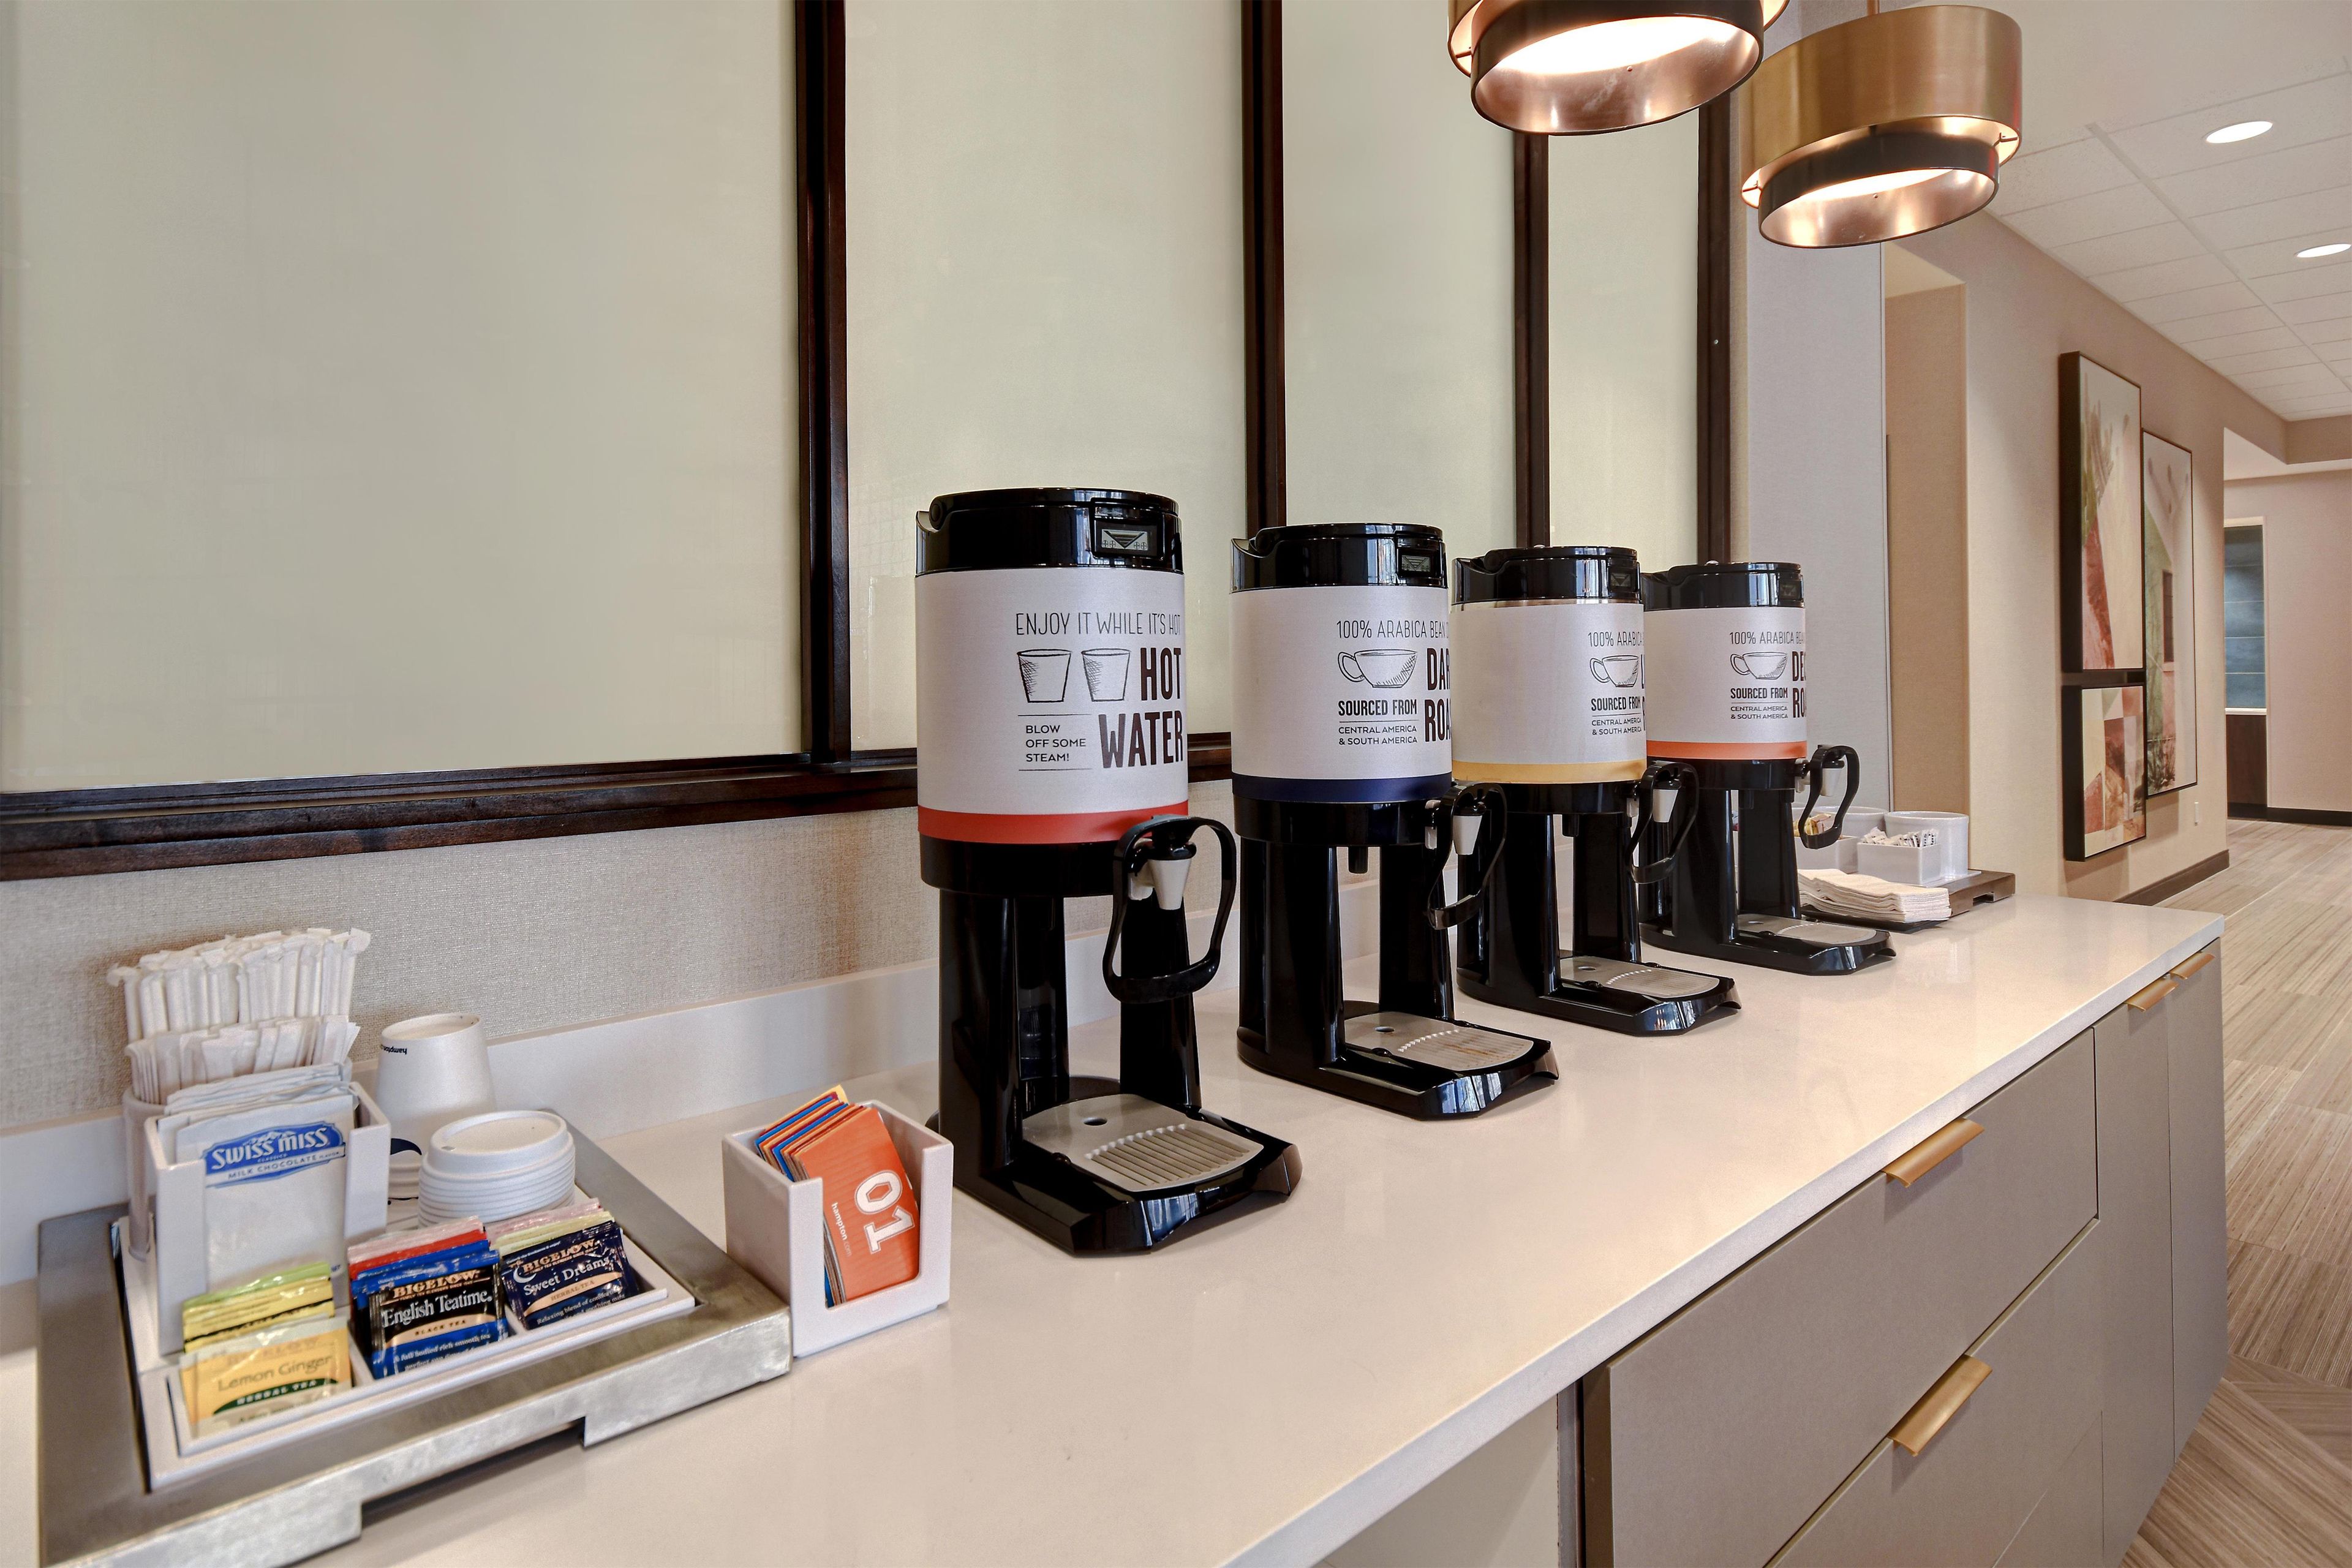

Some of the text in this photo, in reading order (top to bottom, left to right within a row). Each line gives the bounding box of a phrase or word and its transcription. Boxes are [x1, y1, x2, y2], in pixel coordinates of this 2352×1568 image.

[1016, 612, 1180, 635] ENJOY IT WHILE IT'S HOT
[1337, 620, 1372, 638] 100%
[1377, 620, 1427, 638] ARABICA
[1588, 631, 1614, 647] 100%
[1730, 631, 1756, 644] 100%
[1760, 631, 1795, 644] ARABICA
[1140, 647, 1181, 701] HOT
[1427, 648, 1450, 690] DAR
[1591, 696, 1641, 711] SOURCED FROM
[1730, 687, 1788, 699] SOURCED FROM
[1338, 699, 1417, 716] SOURCED FROM
[1026, 725, 1060, 734] BLOW
[1098, 710, 1183, 769] WATER
[1026, 739, 1086, 748] OFF SOME
[1026, 753, 1069, 762] STEAM!
[228, 1169, 253, 1180] MILK
[257, 1154, 317, 1172] CHOCOLATE
[854, 1169, 915, 1254] 01
[522, 1238, 595, 1273] BIGELOW
[393, 1269, 478, 1298] BIGELOW
[524, 1256, 612, 1296] Sweet Dreams
[551, 1280, 595, 1302] HERBAL TEA
[382, 1299, 434, 1328] English
[564, 1302, 581, 1313] blend
[415, 1325, 444, 1336] BLACK
[217, 1354, 333, 1392] Lemon Ginger
